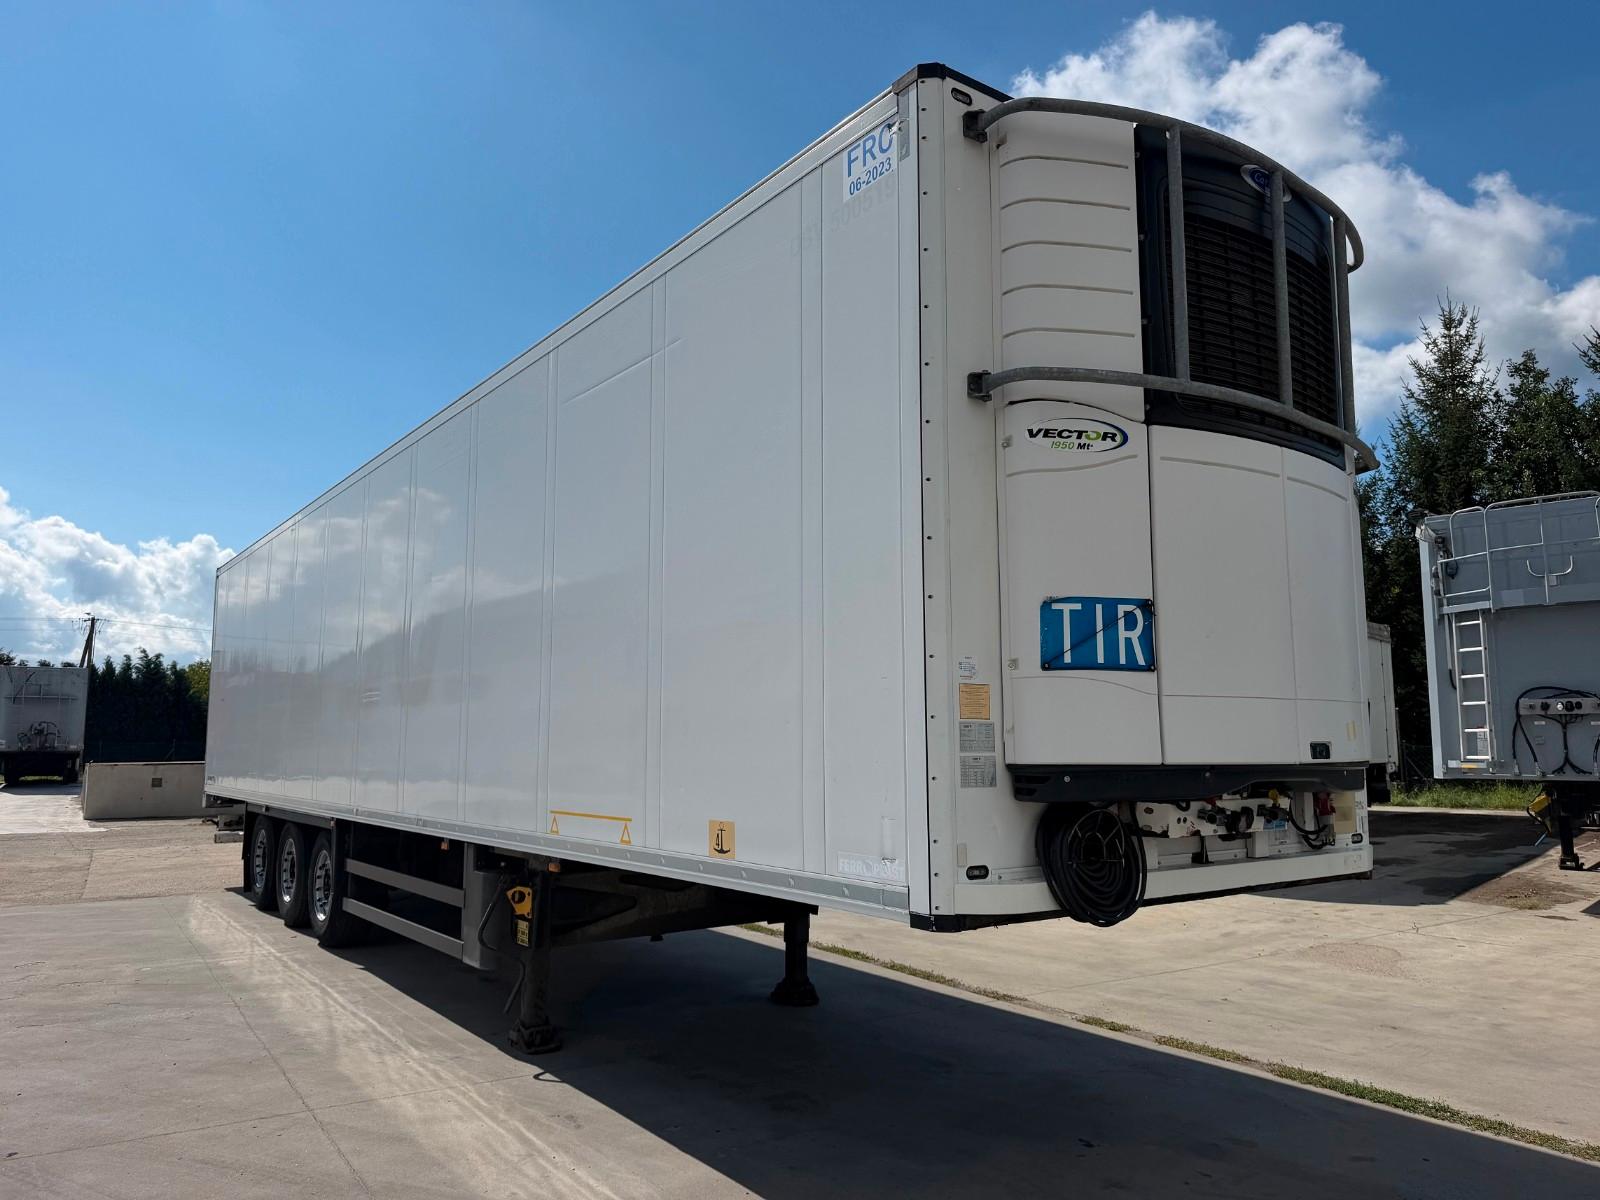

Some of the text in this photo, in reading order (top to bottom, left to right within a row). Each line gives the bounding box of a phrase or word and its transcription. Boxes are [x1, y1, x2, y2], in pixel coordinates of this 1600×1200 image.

[847, 123, 894, 178] FRC
[849, 157, 892, 196] 06-2023
[1027, 428, 1118, 443] VECTOR
[1051, 441, 1075, 450] 1950
[1051, 602, 1146, 666] TIR
